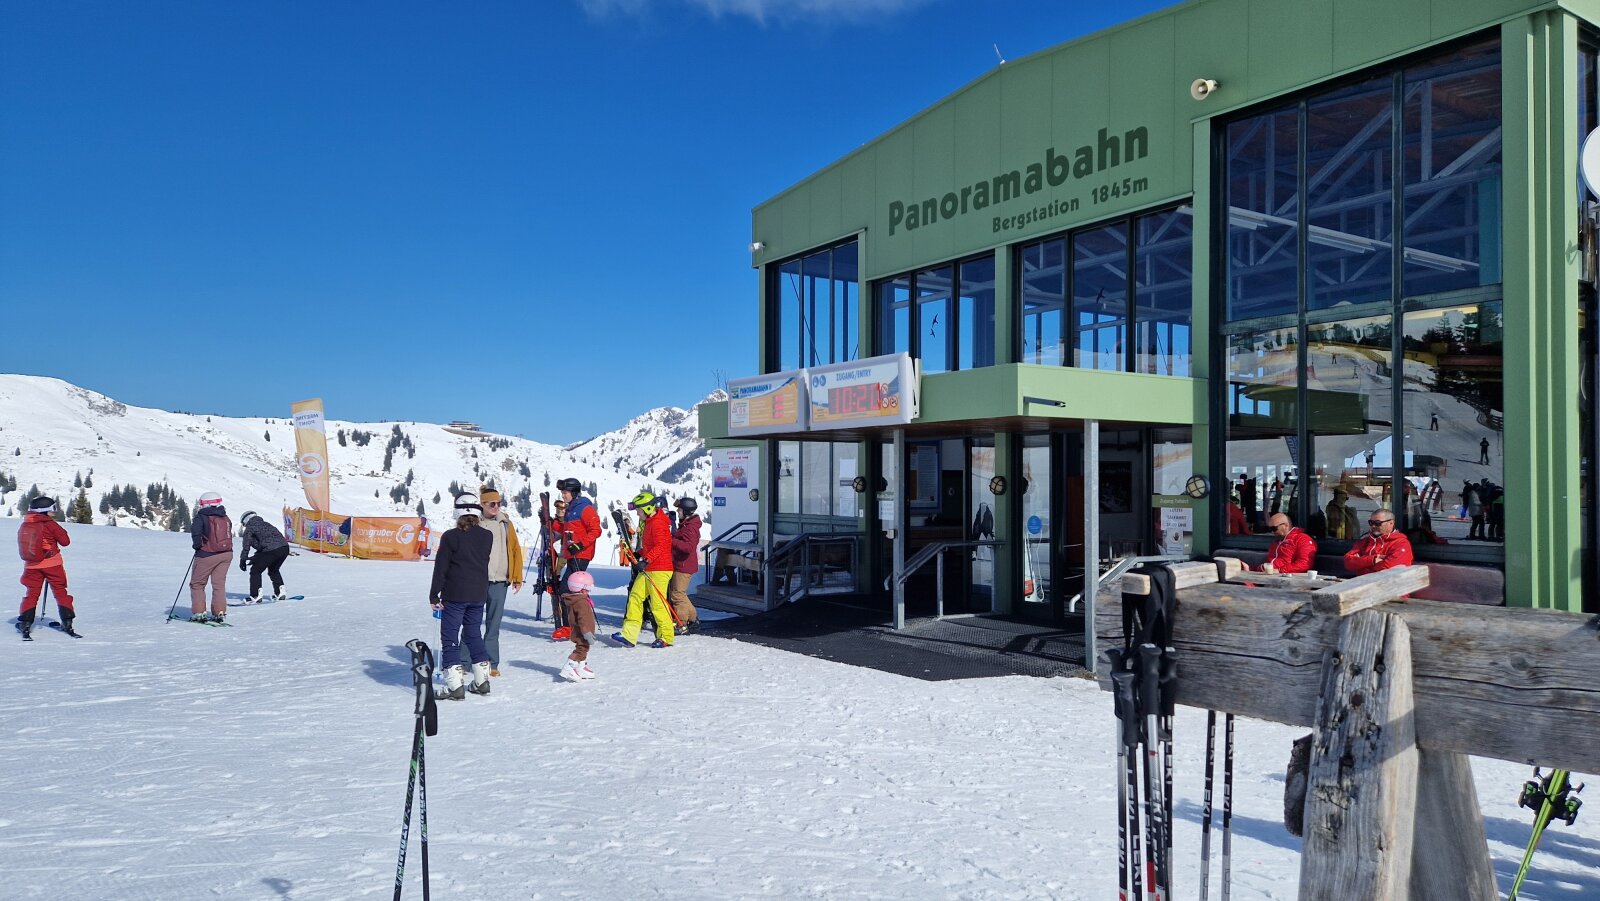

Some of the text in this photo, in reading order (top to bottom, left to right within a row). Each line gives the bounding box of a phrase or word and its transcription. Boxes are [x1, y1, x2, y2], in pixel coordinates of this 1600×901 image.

[888, 126, 1149, 236] Panoramabahn
[993, 177, 1149, 233] Bergstation 1845m
[836, 369, 871, 381] ZUGANG/ENTRY
[836, 383, 880, 415] 10:20
[1152, 777, 1162, 822] LEKI
[1203, 776, 1211, 817] LEKI
[1133, 834, 1142, 886] LEKI
